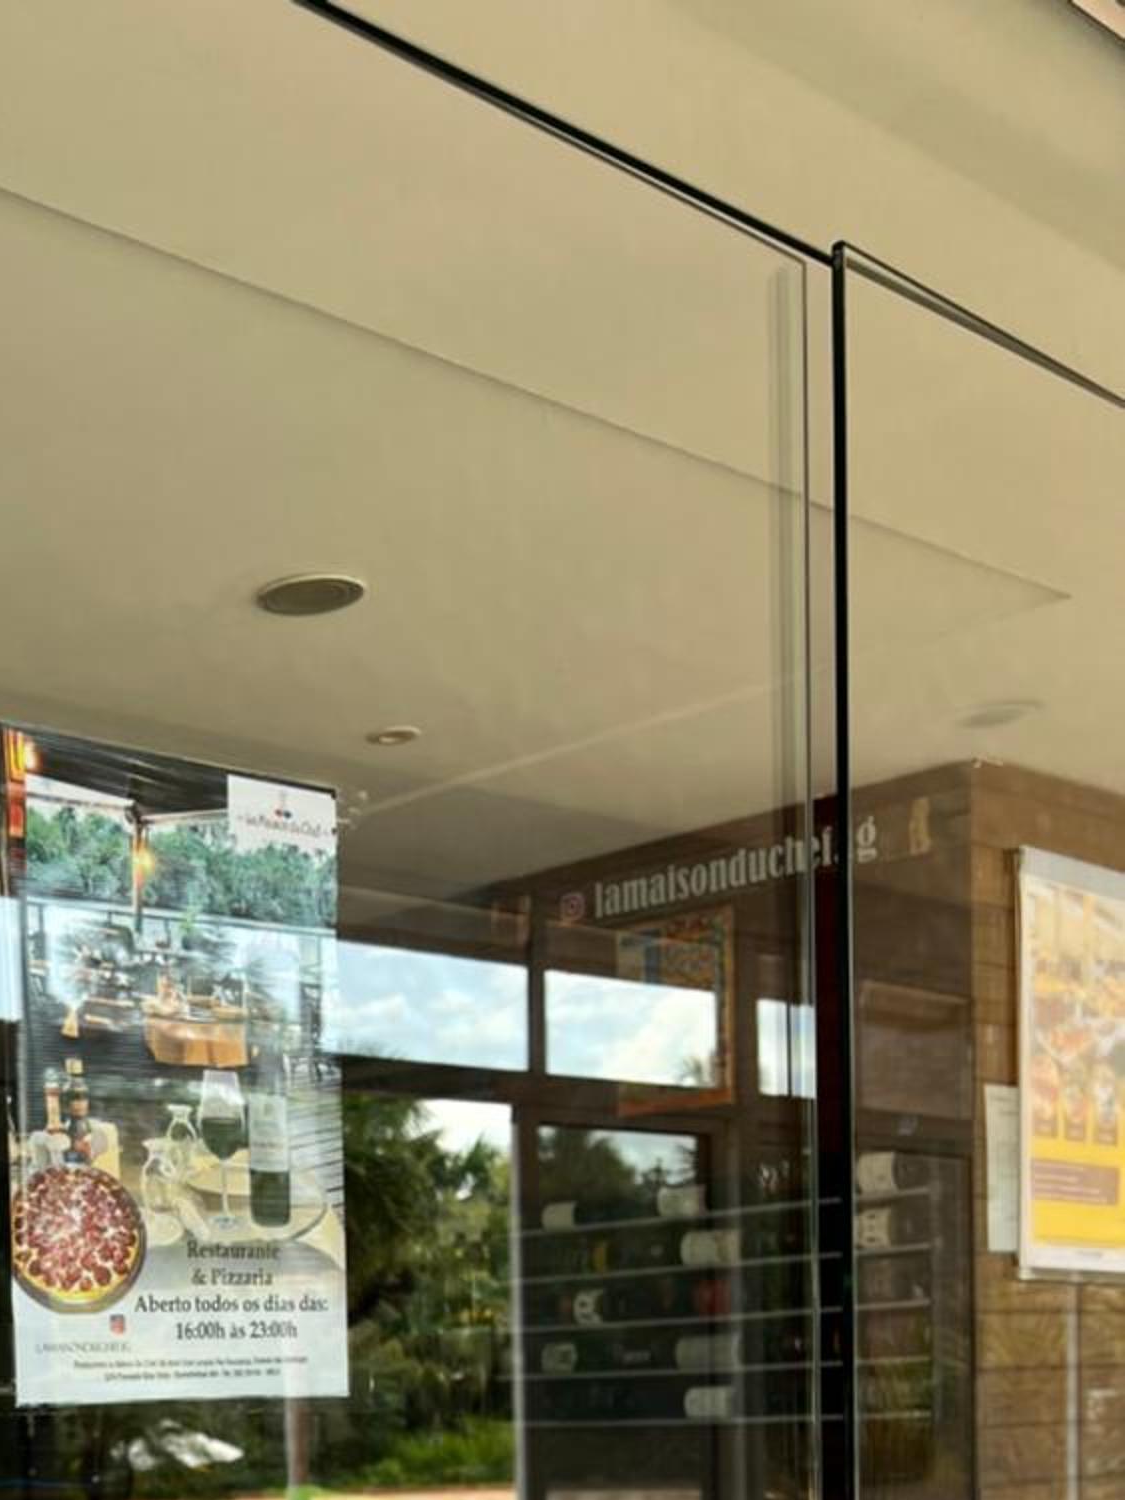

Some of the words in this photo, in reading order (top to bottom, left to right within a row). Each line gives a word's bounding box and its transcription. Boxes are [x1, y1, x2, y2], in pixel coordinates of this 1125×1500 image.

[186, 1240, 279, 1261] Restaurante
[191, 1268, 206, 1286] &
[210, 1267, 274, 1287] Pizzaria
[133, 1296, 193, 1313] Aberto
[195, 1296, 239, 1313] todos
[243, 1300, 261, 1313] os
[263, 1295, 295, 1313] dias
[175, 1321, 226, 1340] 16:00h
[249, 1320, 298, 1339] 23:00h
